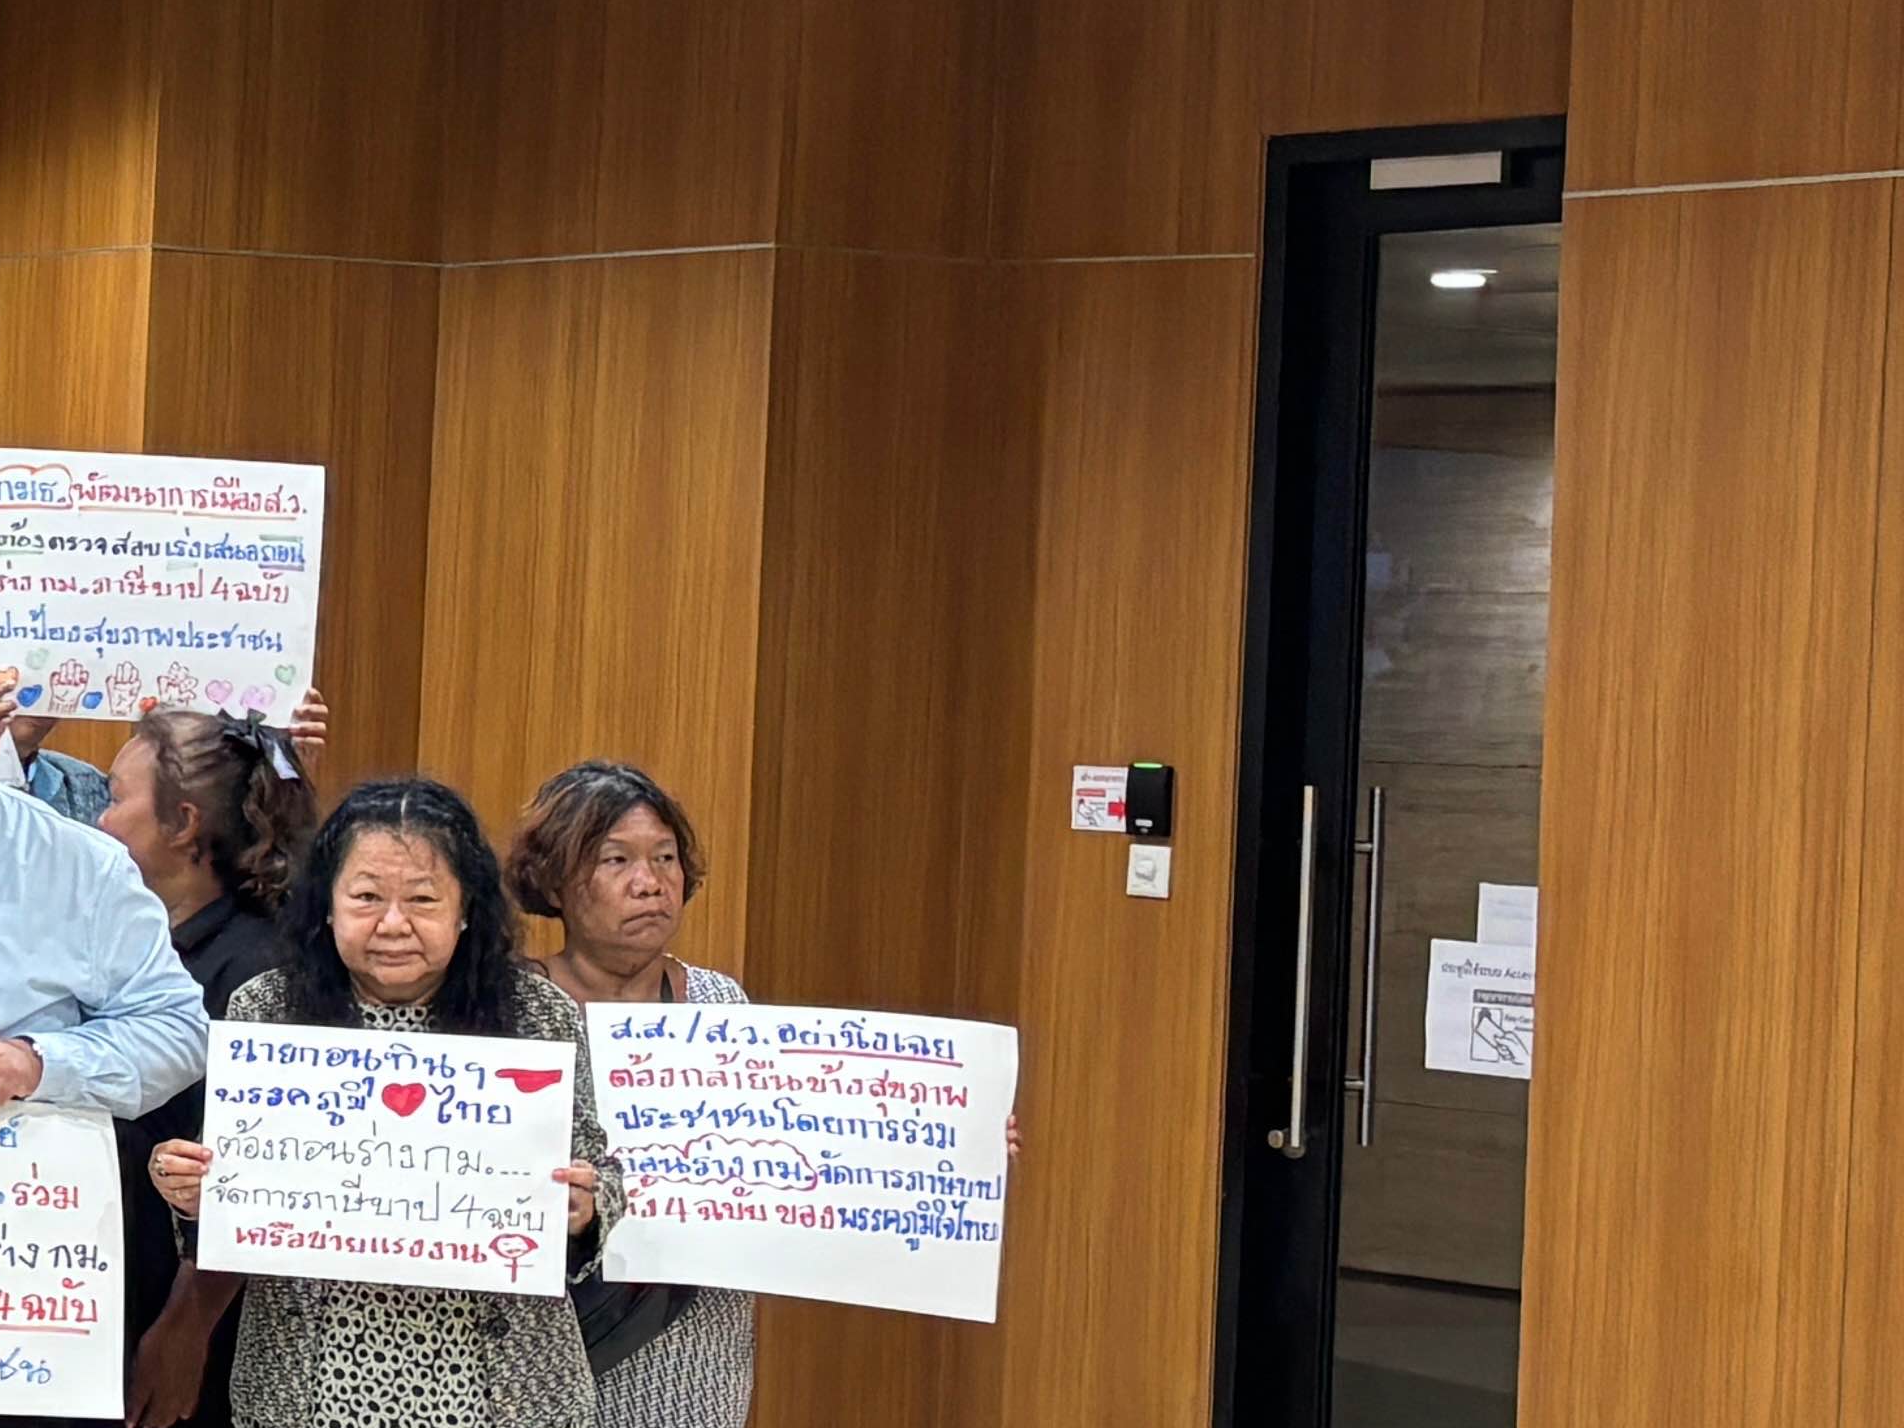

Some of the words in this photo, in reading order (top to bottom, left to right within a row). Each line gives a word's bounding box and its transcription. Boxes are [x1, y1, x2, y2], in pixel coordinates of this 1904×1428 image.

[233, 573, 289, 603] ฉบับ
[779, 1018, 955, 1060] อย่านิ่งเฉย
[616, 1097, 956, 1149] ประชาชนโดยการร่วม
[11, 1163, 79, 1210] ร่วม
[208, 1173, 440, 1222] จัดการภาษีบาป
[482, 1196, 545, 1232] ฉบับ
[697, 1186, 766, 1222] ฉบับ
[236, 1219, 487, 1263] เครือข่ายแรงงาน
[20, 1277, 98, 1324] ฉบับ
